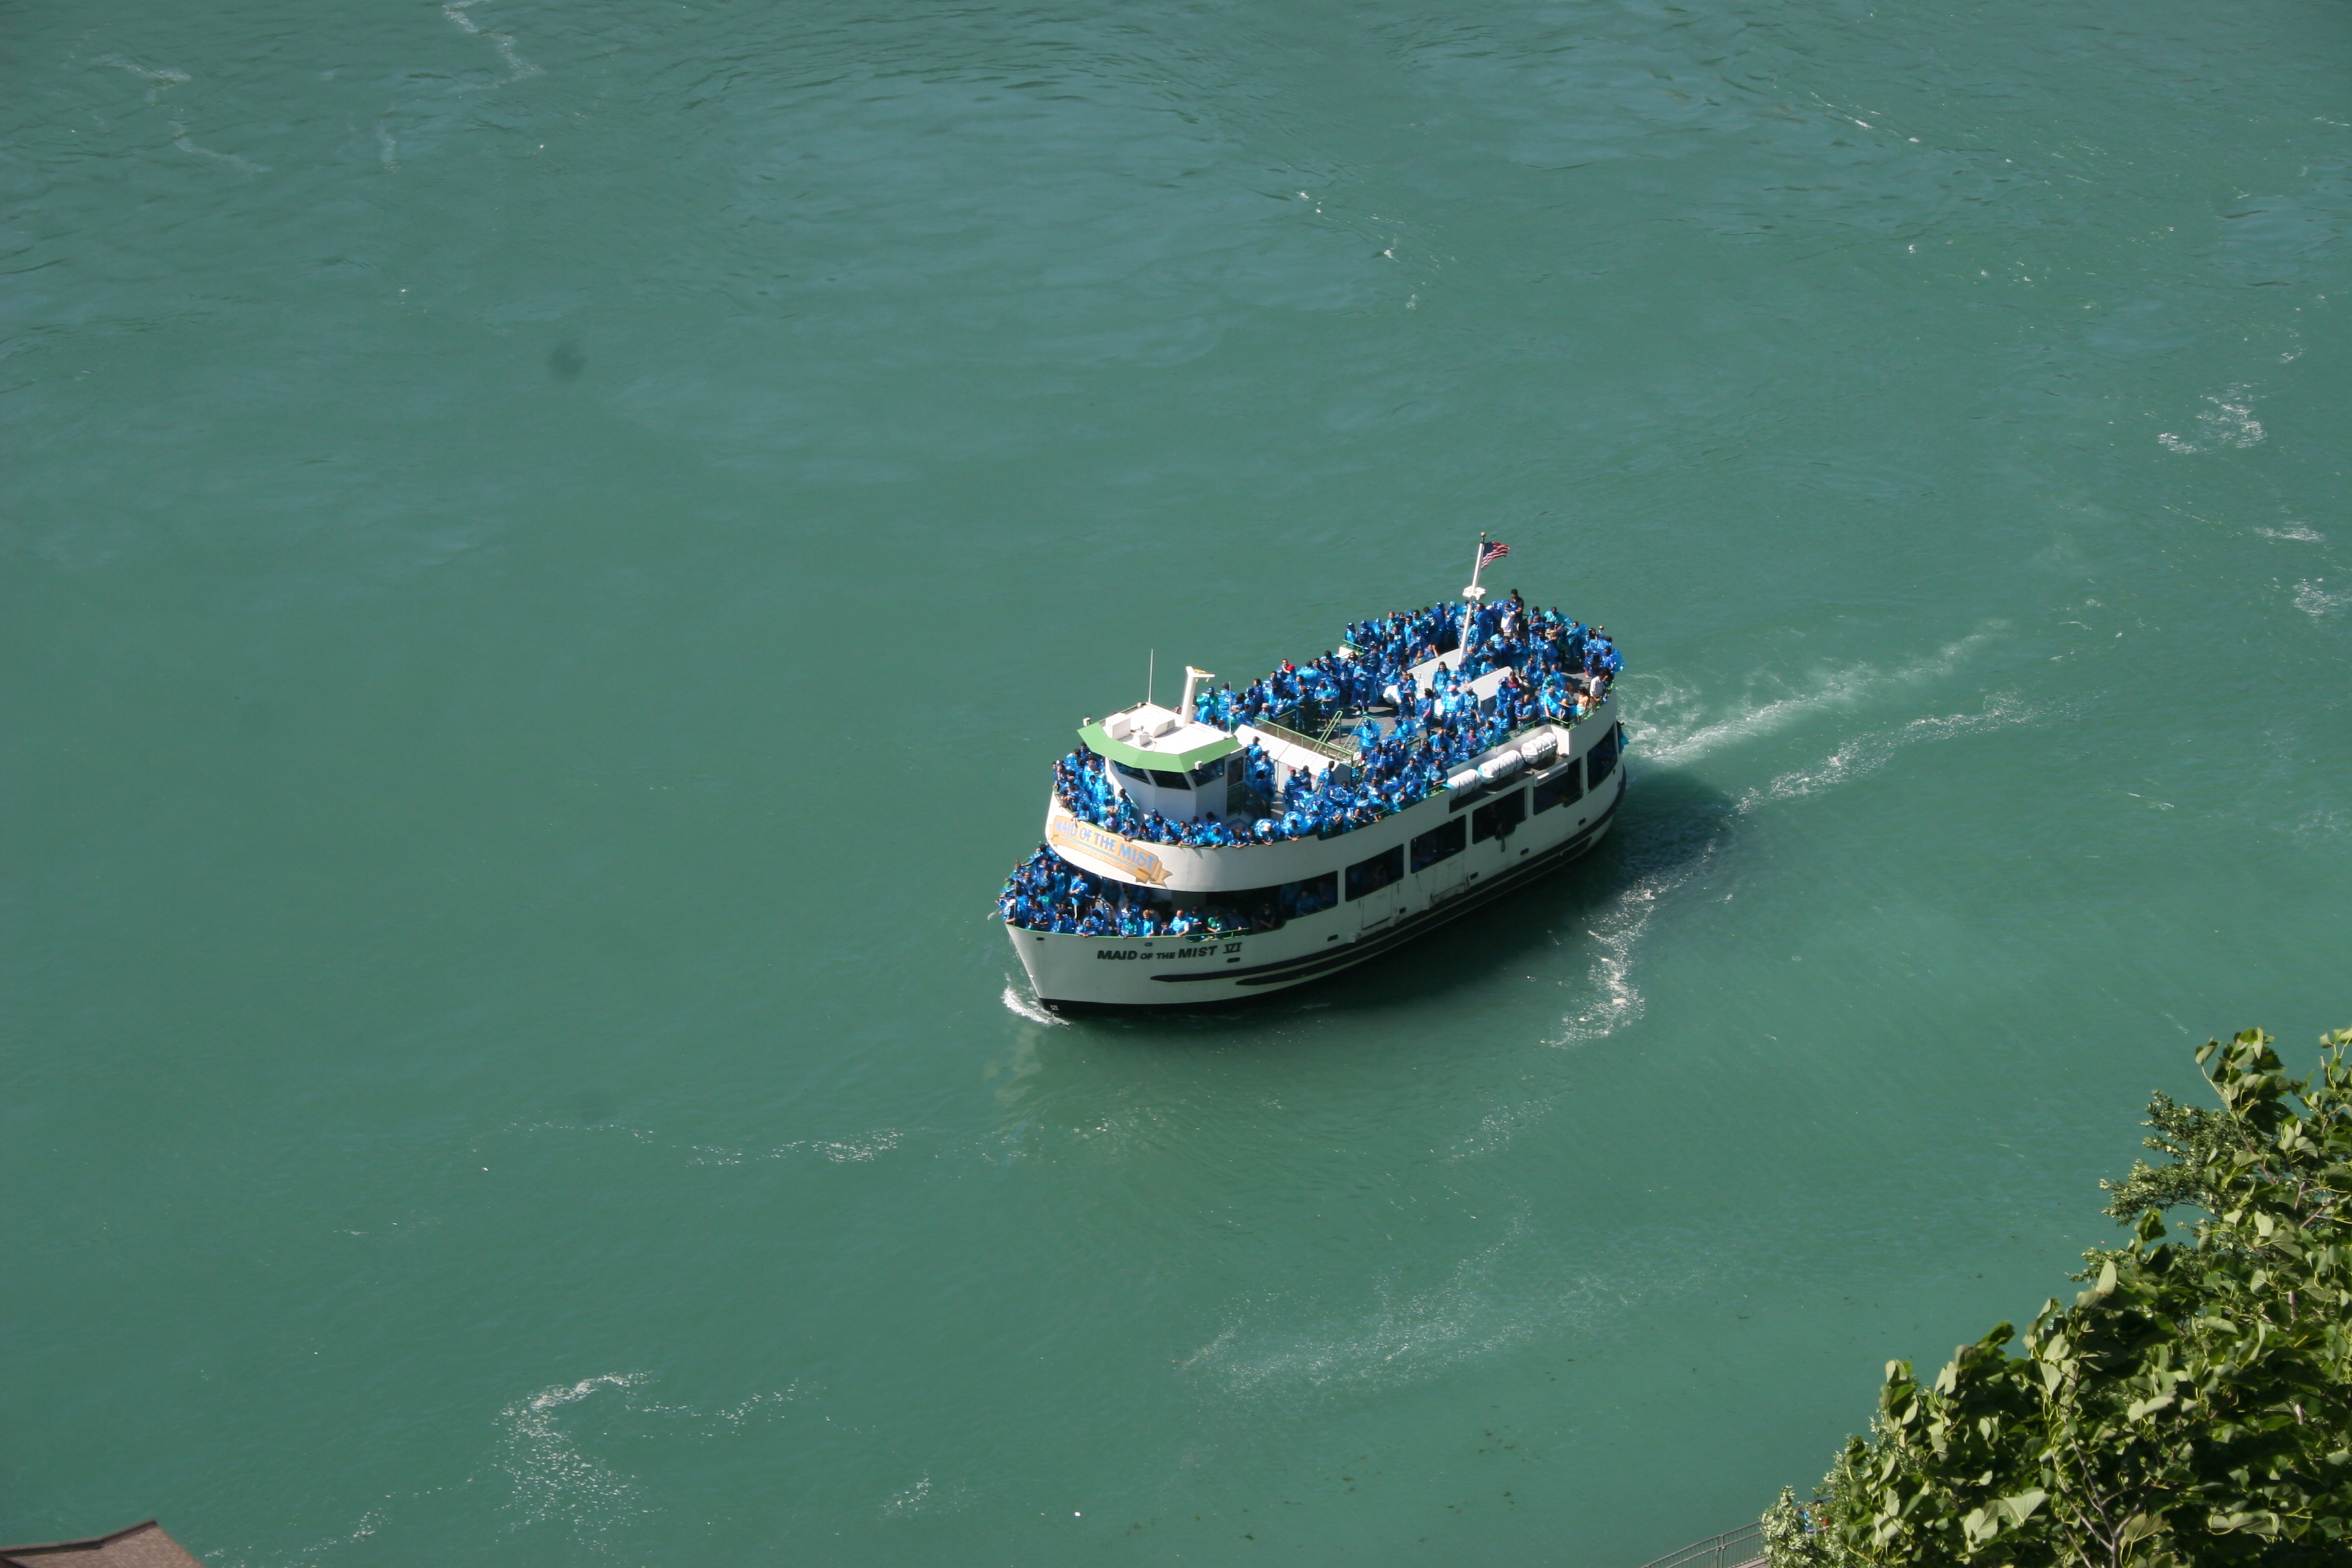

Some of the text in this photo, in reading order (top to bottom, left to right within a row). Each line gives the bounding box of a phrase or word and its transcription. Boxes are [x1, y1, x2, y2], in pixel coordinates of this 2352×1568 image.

[1056, 820, 1077, 836] MAID
[1079, 827, 1092, 842] OF
[1093, 832, 1116, 852] THE
[1118, 842, 1156, 871] MIST
[1097, 950, 1138, 961] MAID
[1178, 945, 1218, 959] MIST
[1223, 942, 1242, 954] VI
